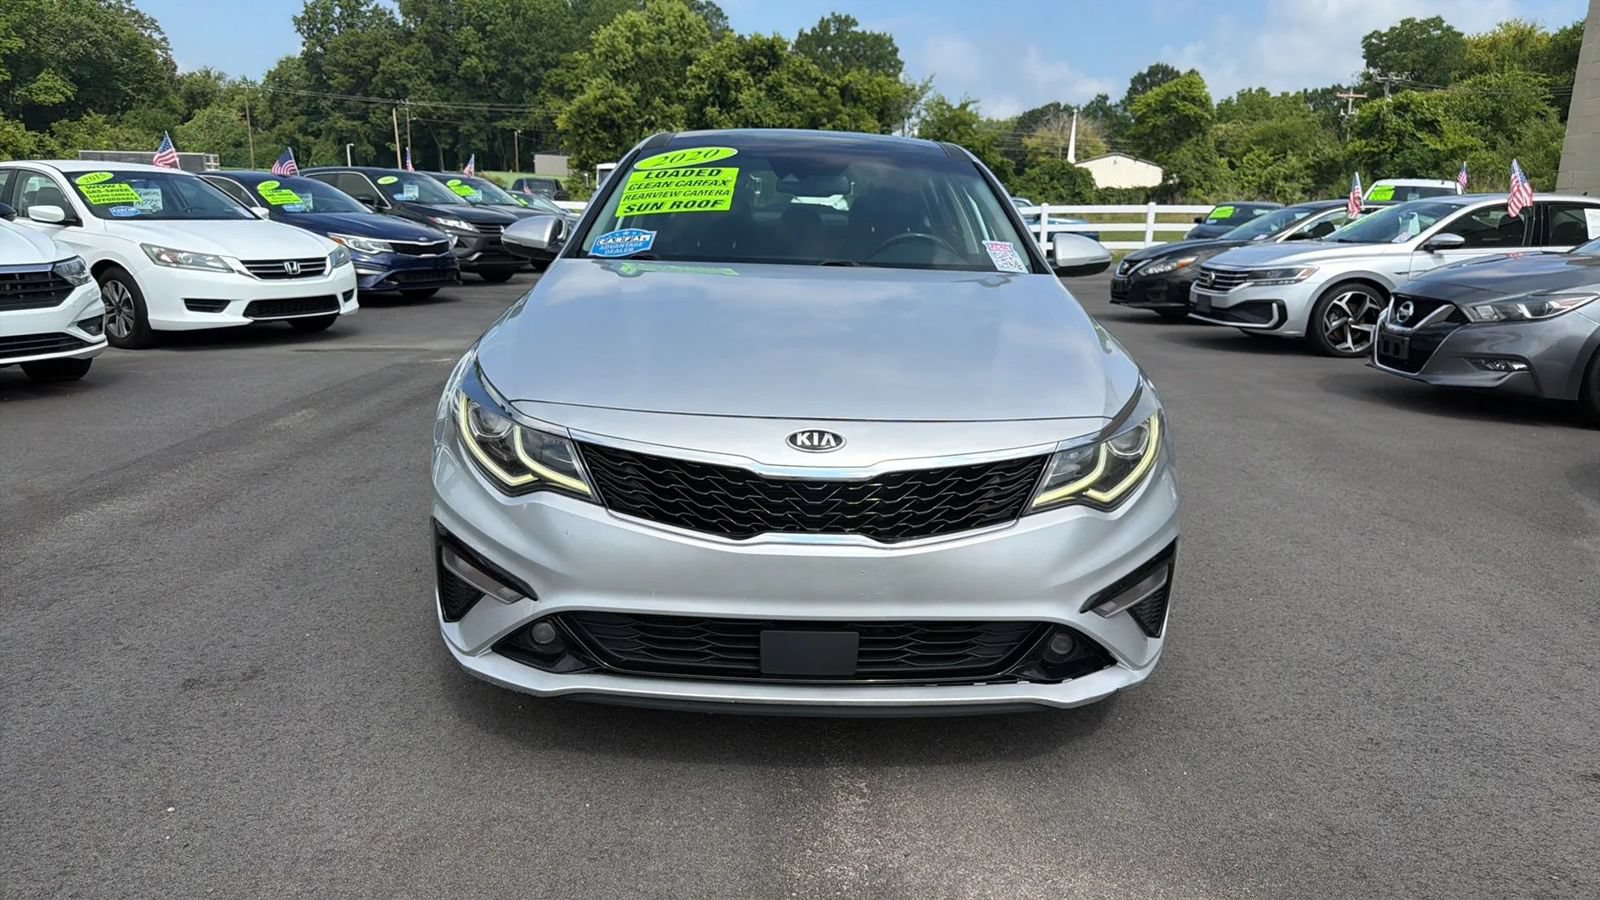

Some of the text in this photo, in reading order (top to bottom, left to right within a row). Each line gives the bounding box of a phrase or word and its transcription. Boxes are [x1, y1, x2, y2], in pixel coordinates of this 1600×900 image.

[650, 149, 720, 167] 2020
[644, 169, 721, 180] LOADED
[628, 179, 729, 191] CLEAN CARFAX
[624, 189, 730, 201] REARVIEW CAMERA
[624, 200, 725, 213] SUN ROOF
[604, 247, 635, 255] DEALER
[796, 432, 837, 447] KIA
